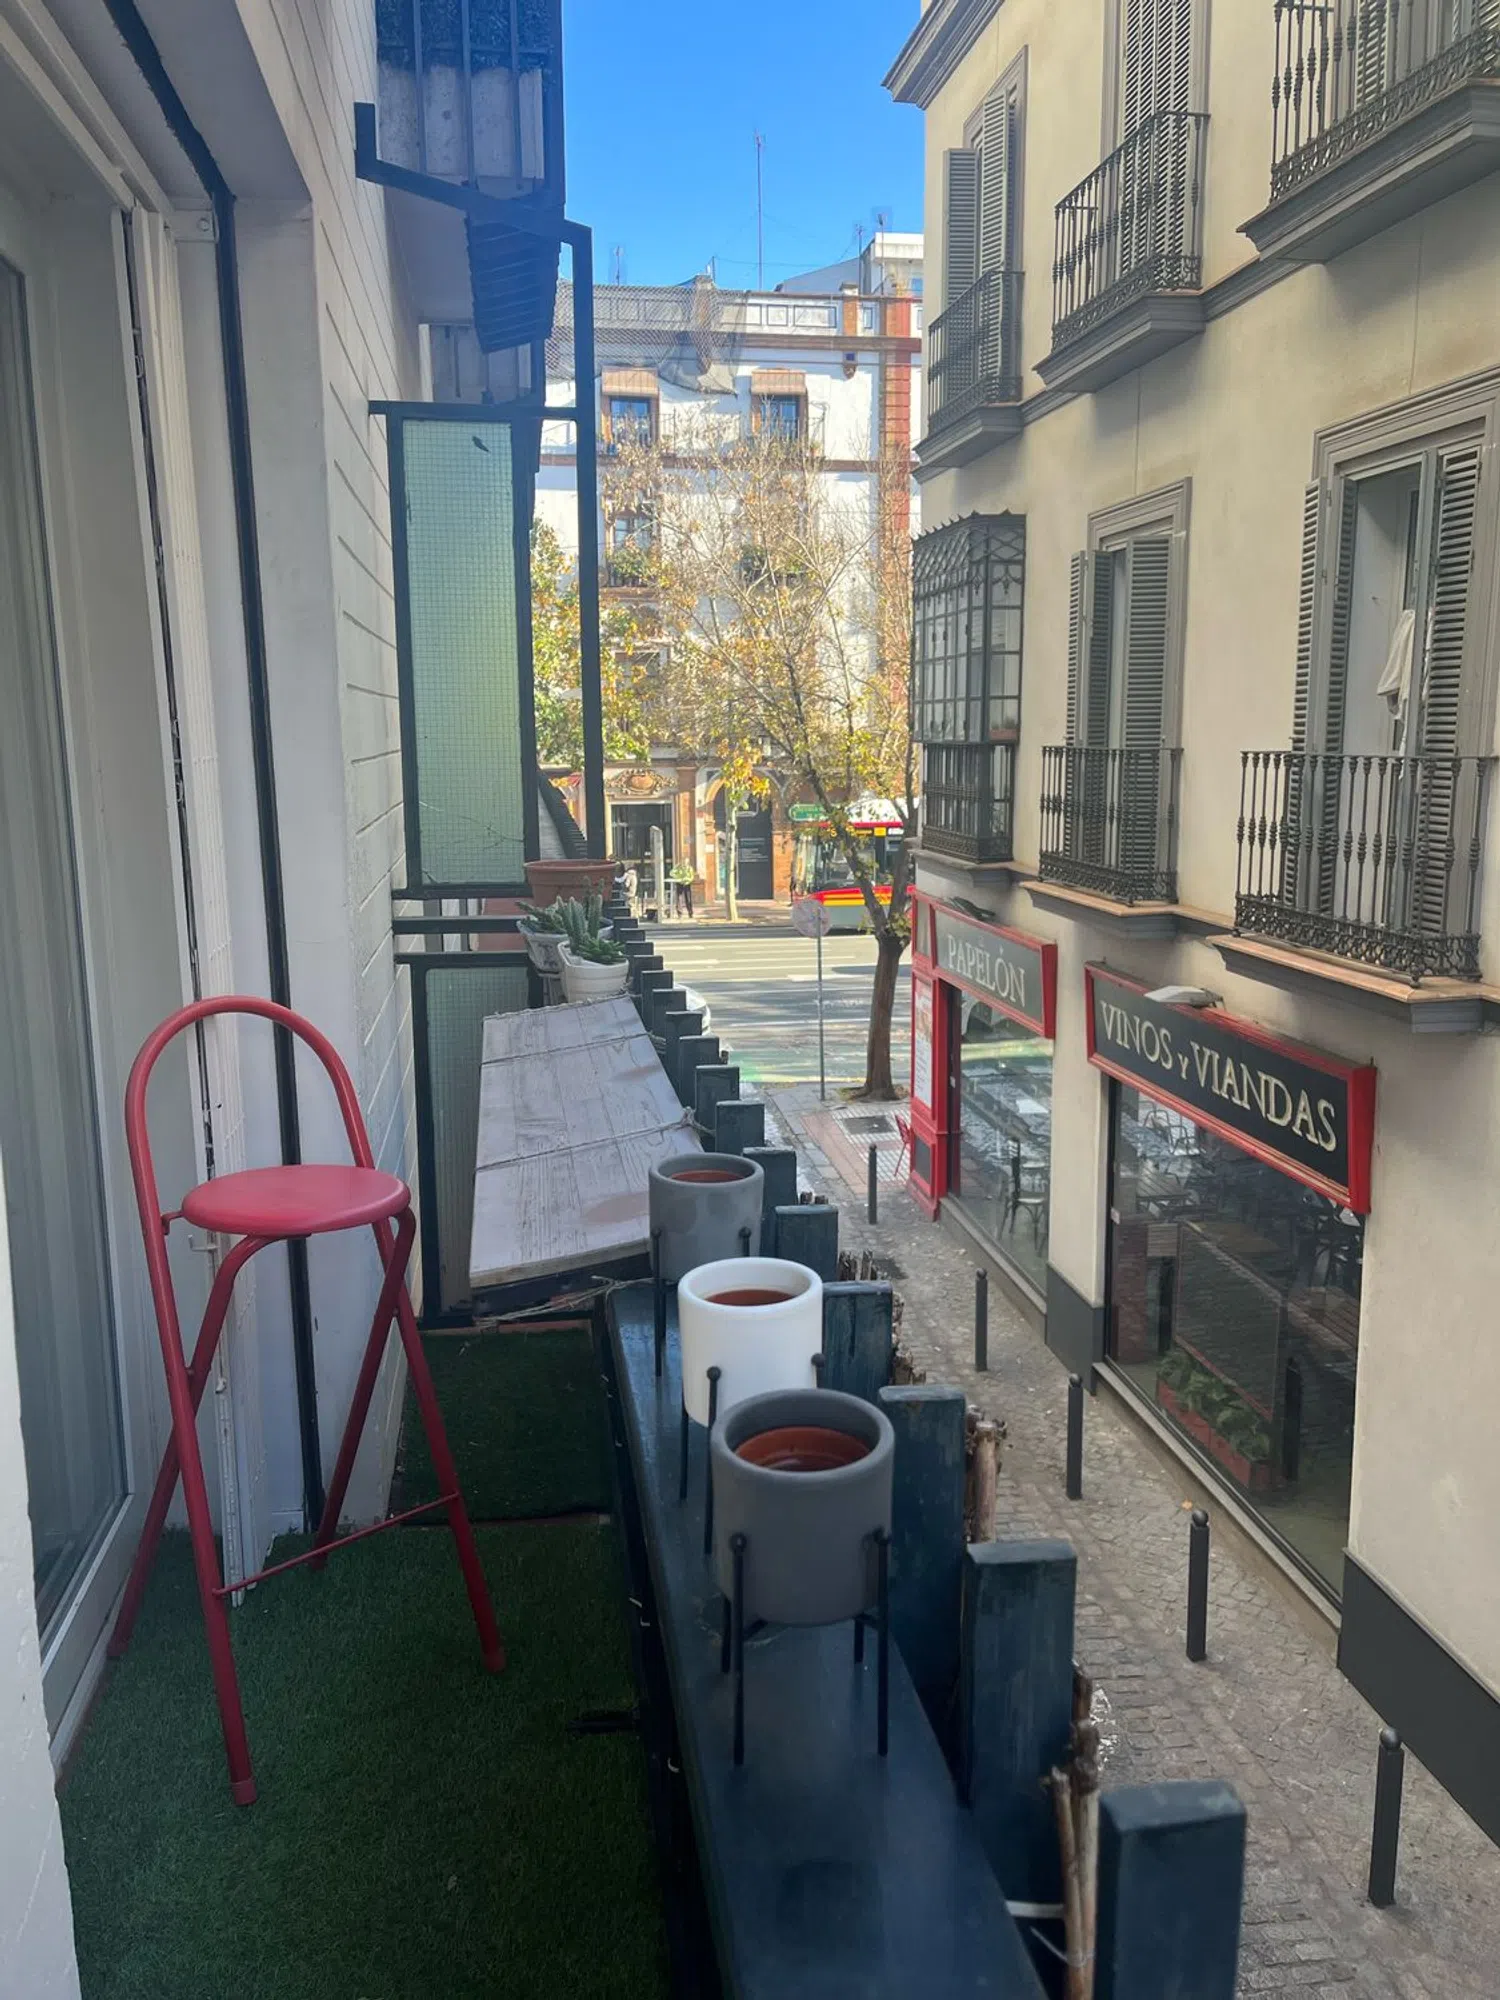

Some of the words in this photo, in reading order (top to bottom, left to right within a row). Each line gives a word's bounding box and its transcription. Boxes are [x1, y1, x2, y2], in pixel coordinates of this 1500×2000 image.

[947, 934, 1025, 1007] PAPELÓN
[1101, 1001, 1173, 1070] VINOS
[1190, 1041, 1336, 1152] VIANDAS
